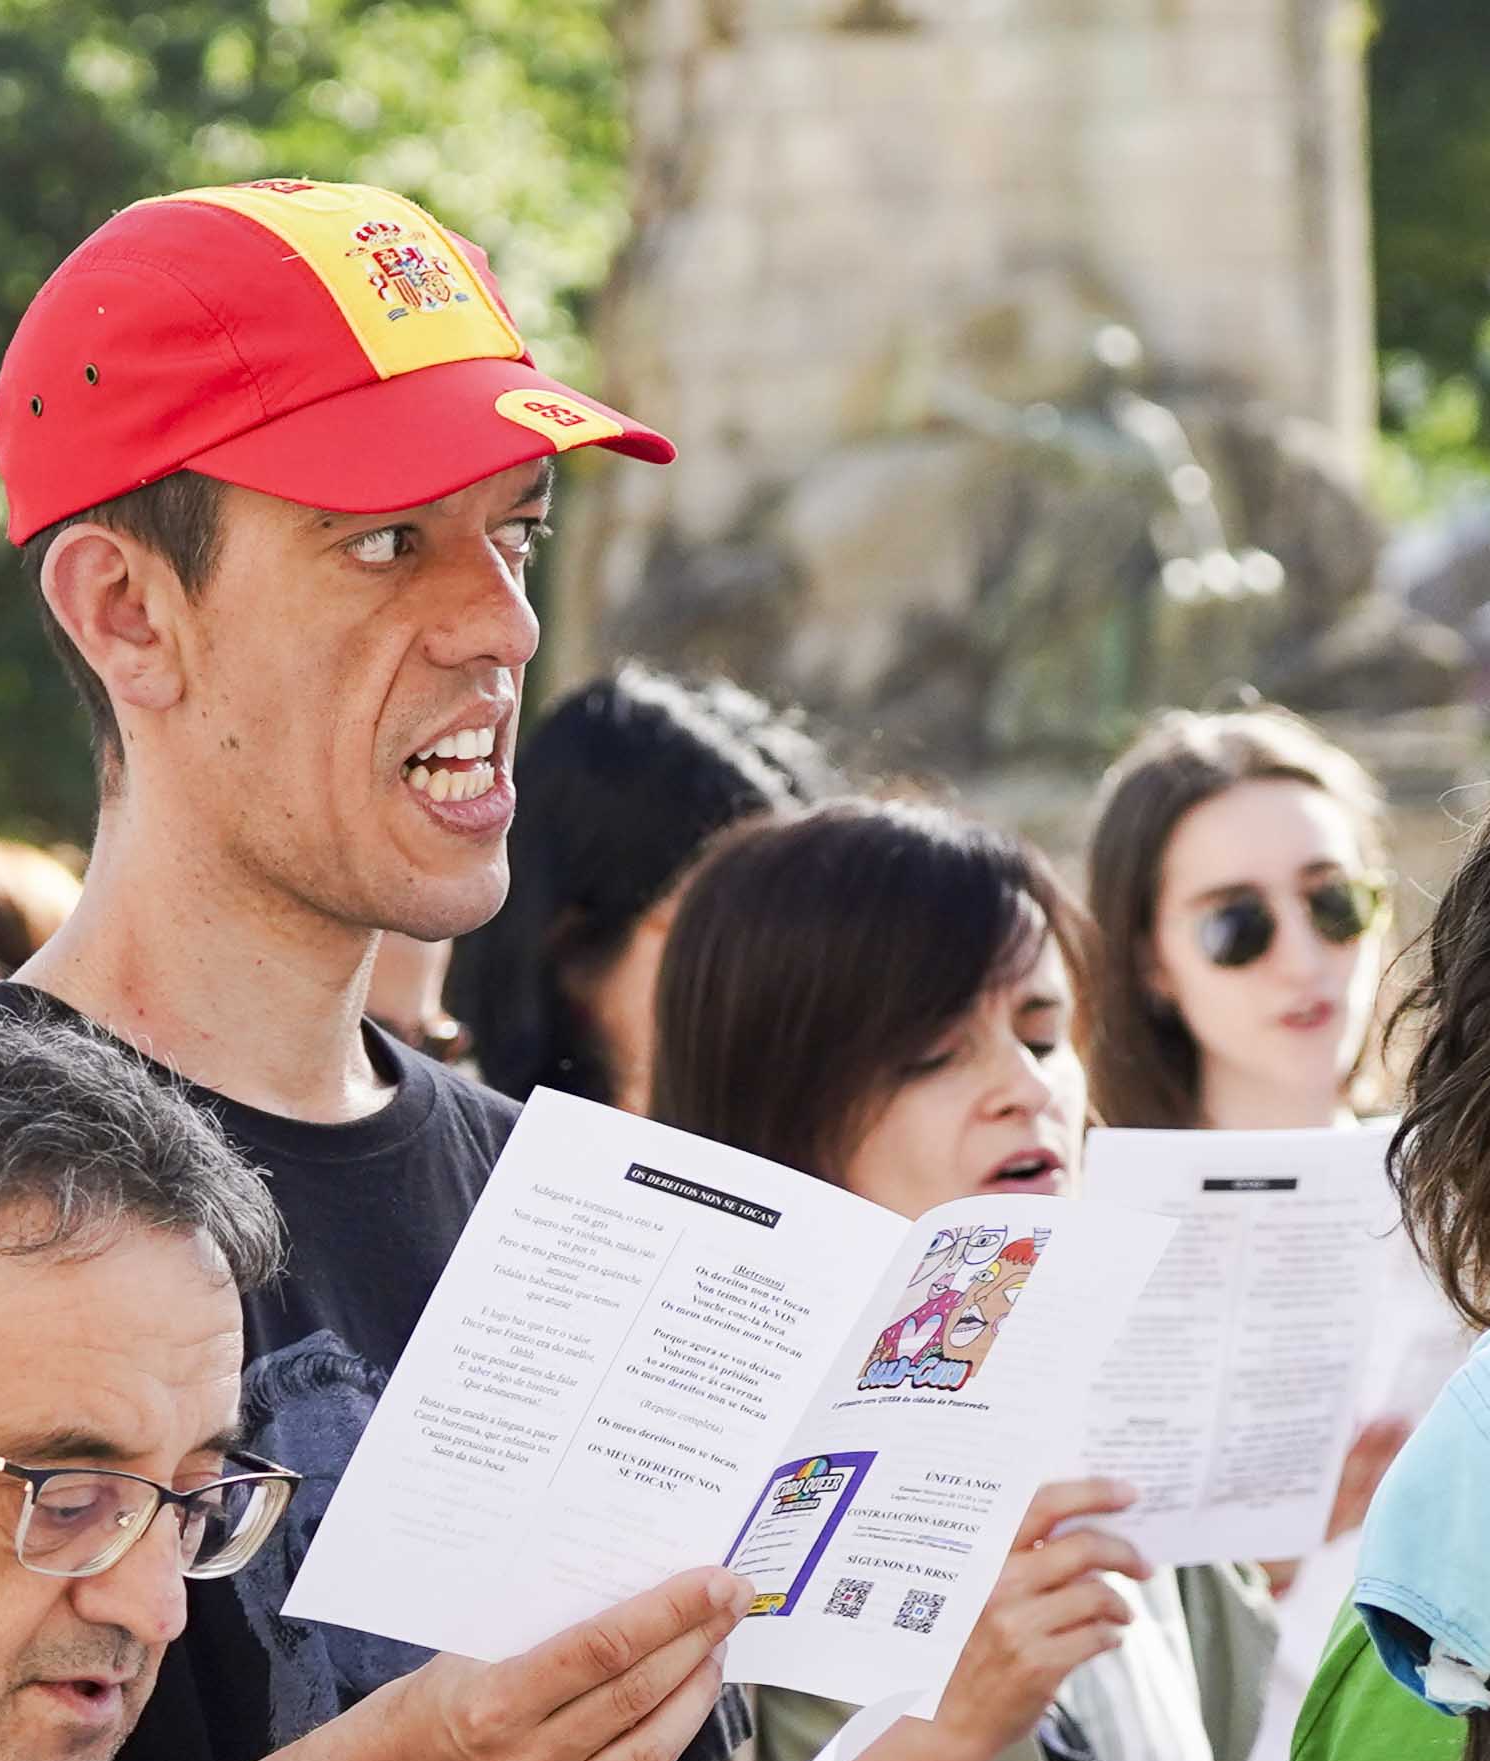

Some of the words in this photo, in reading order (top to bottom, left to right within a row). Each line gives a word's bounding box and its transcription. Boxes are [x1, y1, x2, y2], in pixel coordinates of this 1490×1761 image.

[523, 402, 587, 427] ESP
[630, 1168, 647, 1180] OS
[646, 1173, 699, 1198] DEREITOS
[698, 1191, 722, 1206] NON
[721, 1199, 737, 1211] SE
[737, 1204, 775, 1224] TOCAN
[697, 1281, 714, 1293] Non
[717, 1289, 746, 1305] teimes
[710, 1272, 748, 1290] dereitos
[751, 1288, 768, 1297] non
[783, 1299, 809, 1314] tocan
[676, 1307, 700, 1318] meus
[703, 1315, 740, 1333] dereitos
[742, 1331, 761, 1341] non
[775, 1342, 801, 1358] tocan
[762, 1321, 785, 1335] boca
[653, 1328, 687, 1344] Porque
[690, 1343, 716, 1355] agora
[732, 1357, 746, 1366] vos
[749, 1363, 781, 1380] deixan
[663, 1345, 705, 1366] Volvemos
[641, 1371, 665, 1383] meus
[667, 1379, 705, 1396] dereitos
[707, 1393, 725, 1404] non
[740, 1404, 766, 1419] tocan
[659, 1362, 698, 1379] armario
[720, 1383, 761, 1402] cavernas
[612, 1422, 636, 1433] meus
[638, 1430, 675, 1446] dereitos
[678, 1443, 696, 1453] non
[607, 1448, 635, 1463] MEUS
[637, 1458, 694, 1482] DEREITOS
[699, 1478, 720, 1492] NON
[906, 1563, 923, 1574] EN
[924, 1566, 959, 1583] RRSS!
